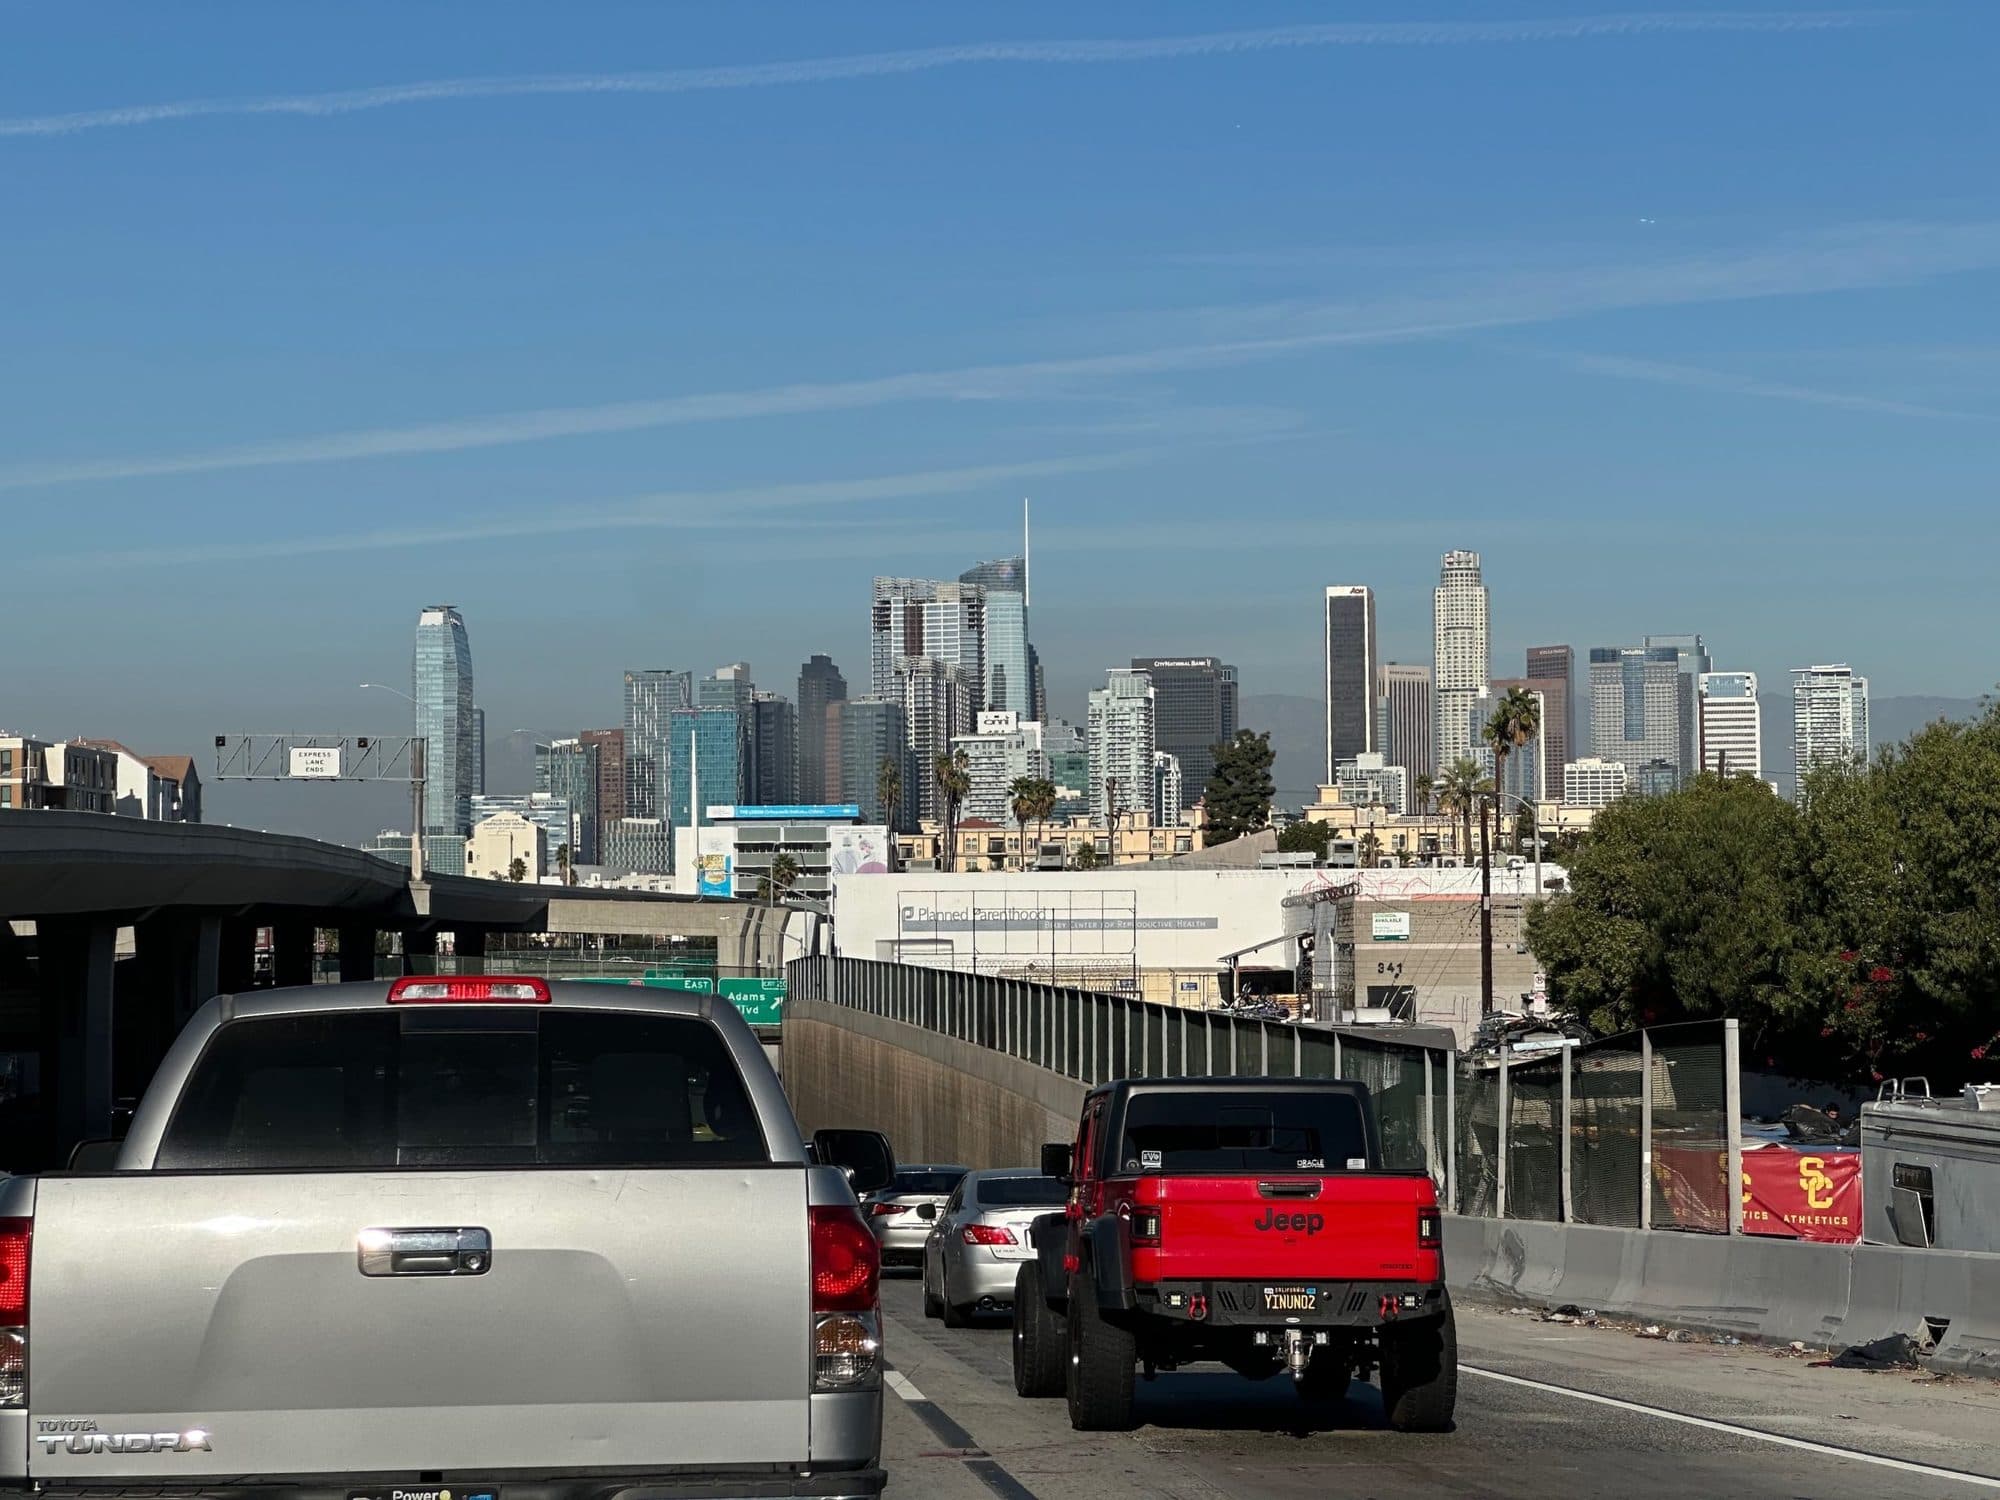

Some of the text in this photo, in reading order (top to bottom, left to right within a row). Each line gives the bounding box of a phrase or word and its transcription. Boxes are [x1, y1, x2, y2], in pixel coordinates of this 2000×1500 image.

[918, 907, 1047, 921] Planned Parenthood
[1377, 962, 1402, 974] 341
[684, 980, 709, 989] EAST
[728, 992, 766, 1001] Adams
[1800, 1156, 1834, 1209] SC
[1255, 1208, 1324, 1235] Jeep
[1784, 1215, 1849, 1226] ATHLETICS
[37, 1419, 98, 1432] TOYOTA
[37, 1430, 213, 1455] TUNDRA
[392, 1490, 440, 1500] Power
